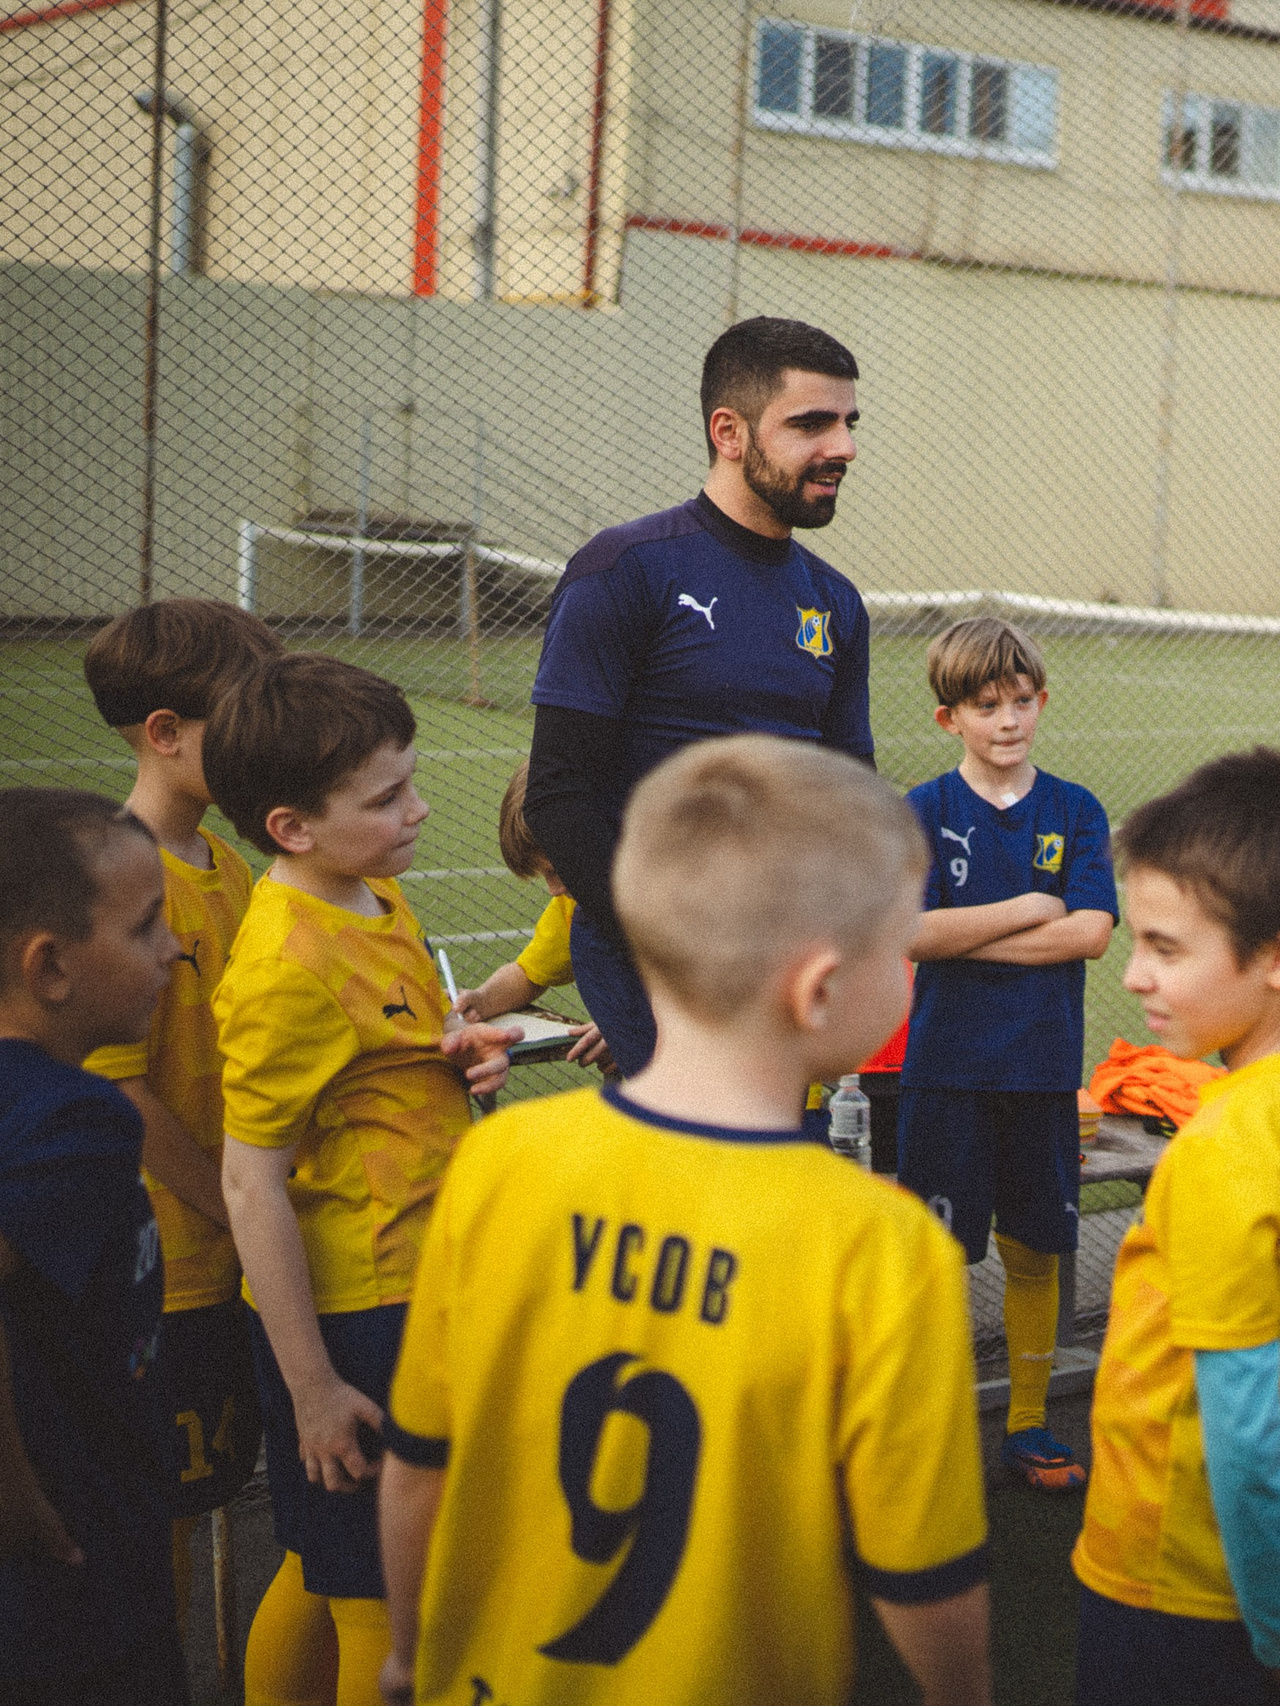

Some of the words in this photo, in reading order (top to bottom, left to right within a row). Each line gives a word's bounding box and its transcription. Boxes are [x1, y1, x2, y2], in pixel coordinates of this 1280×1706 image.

[949, 857, 969, 887] 9
[571, 1212, 740, 1327] УСОВ
[536, 1351, 704, 1668] 9
